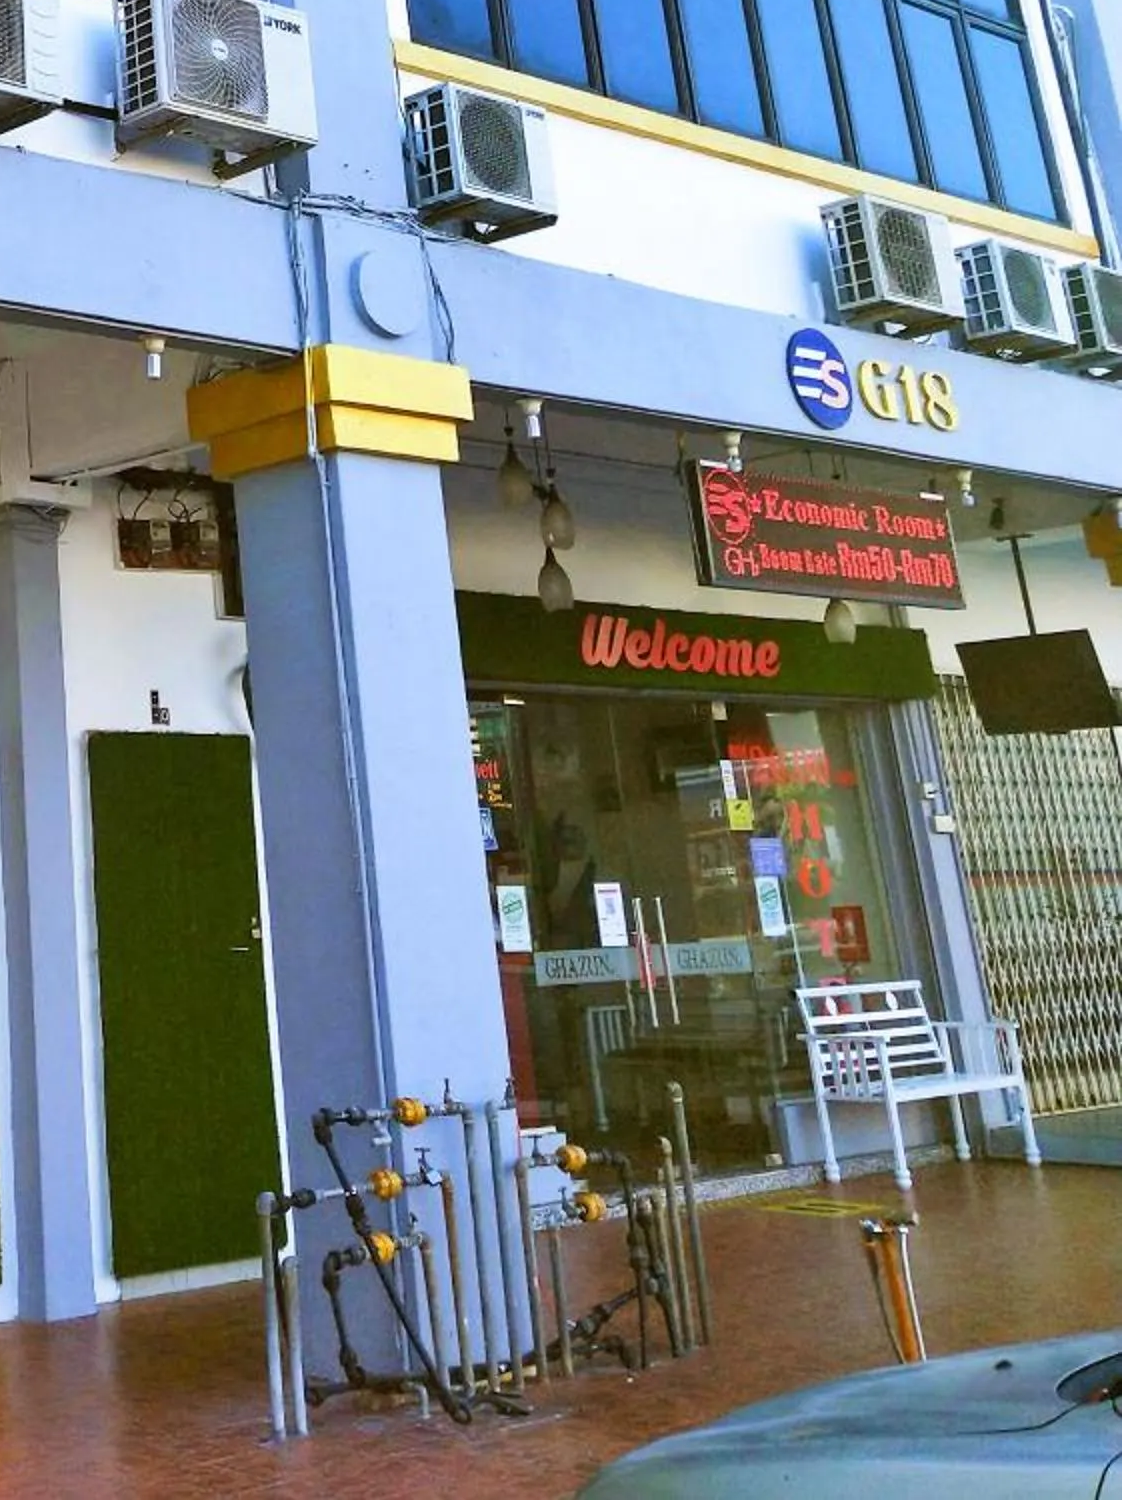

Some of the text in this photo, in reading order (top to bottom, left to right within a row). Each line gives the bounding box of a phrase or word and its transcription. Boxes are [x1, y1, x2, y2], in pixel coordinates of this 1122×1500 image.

[857, 358, 959, 432] G18
[761, 488, 937, 540] Economic Room
[581, 612, 782, 678] Welcome
